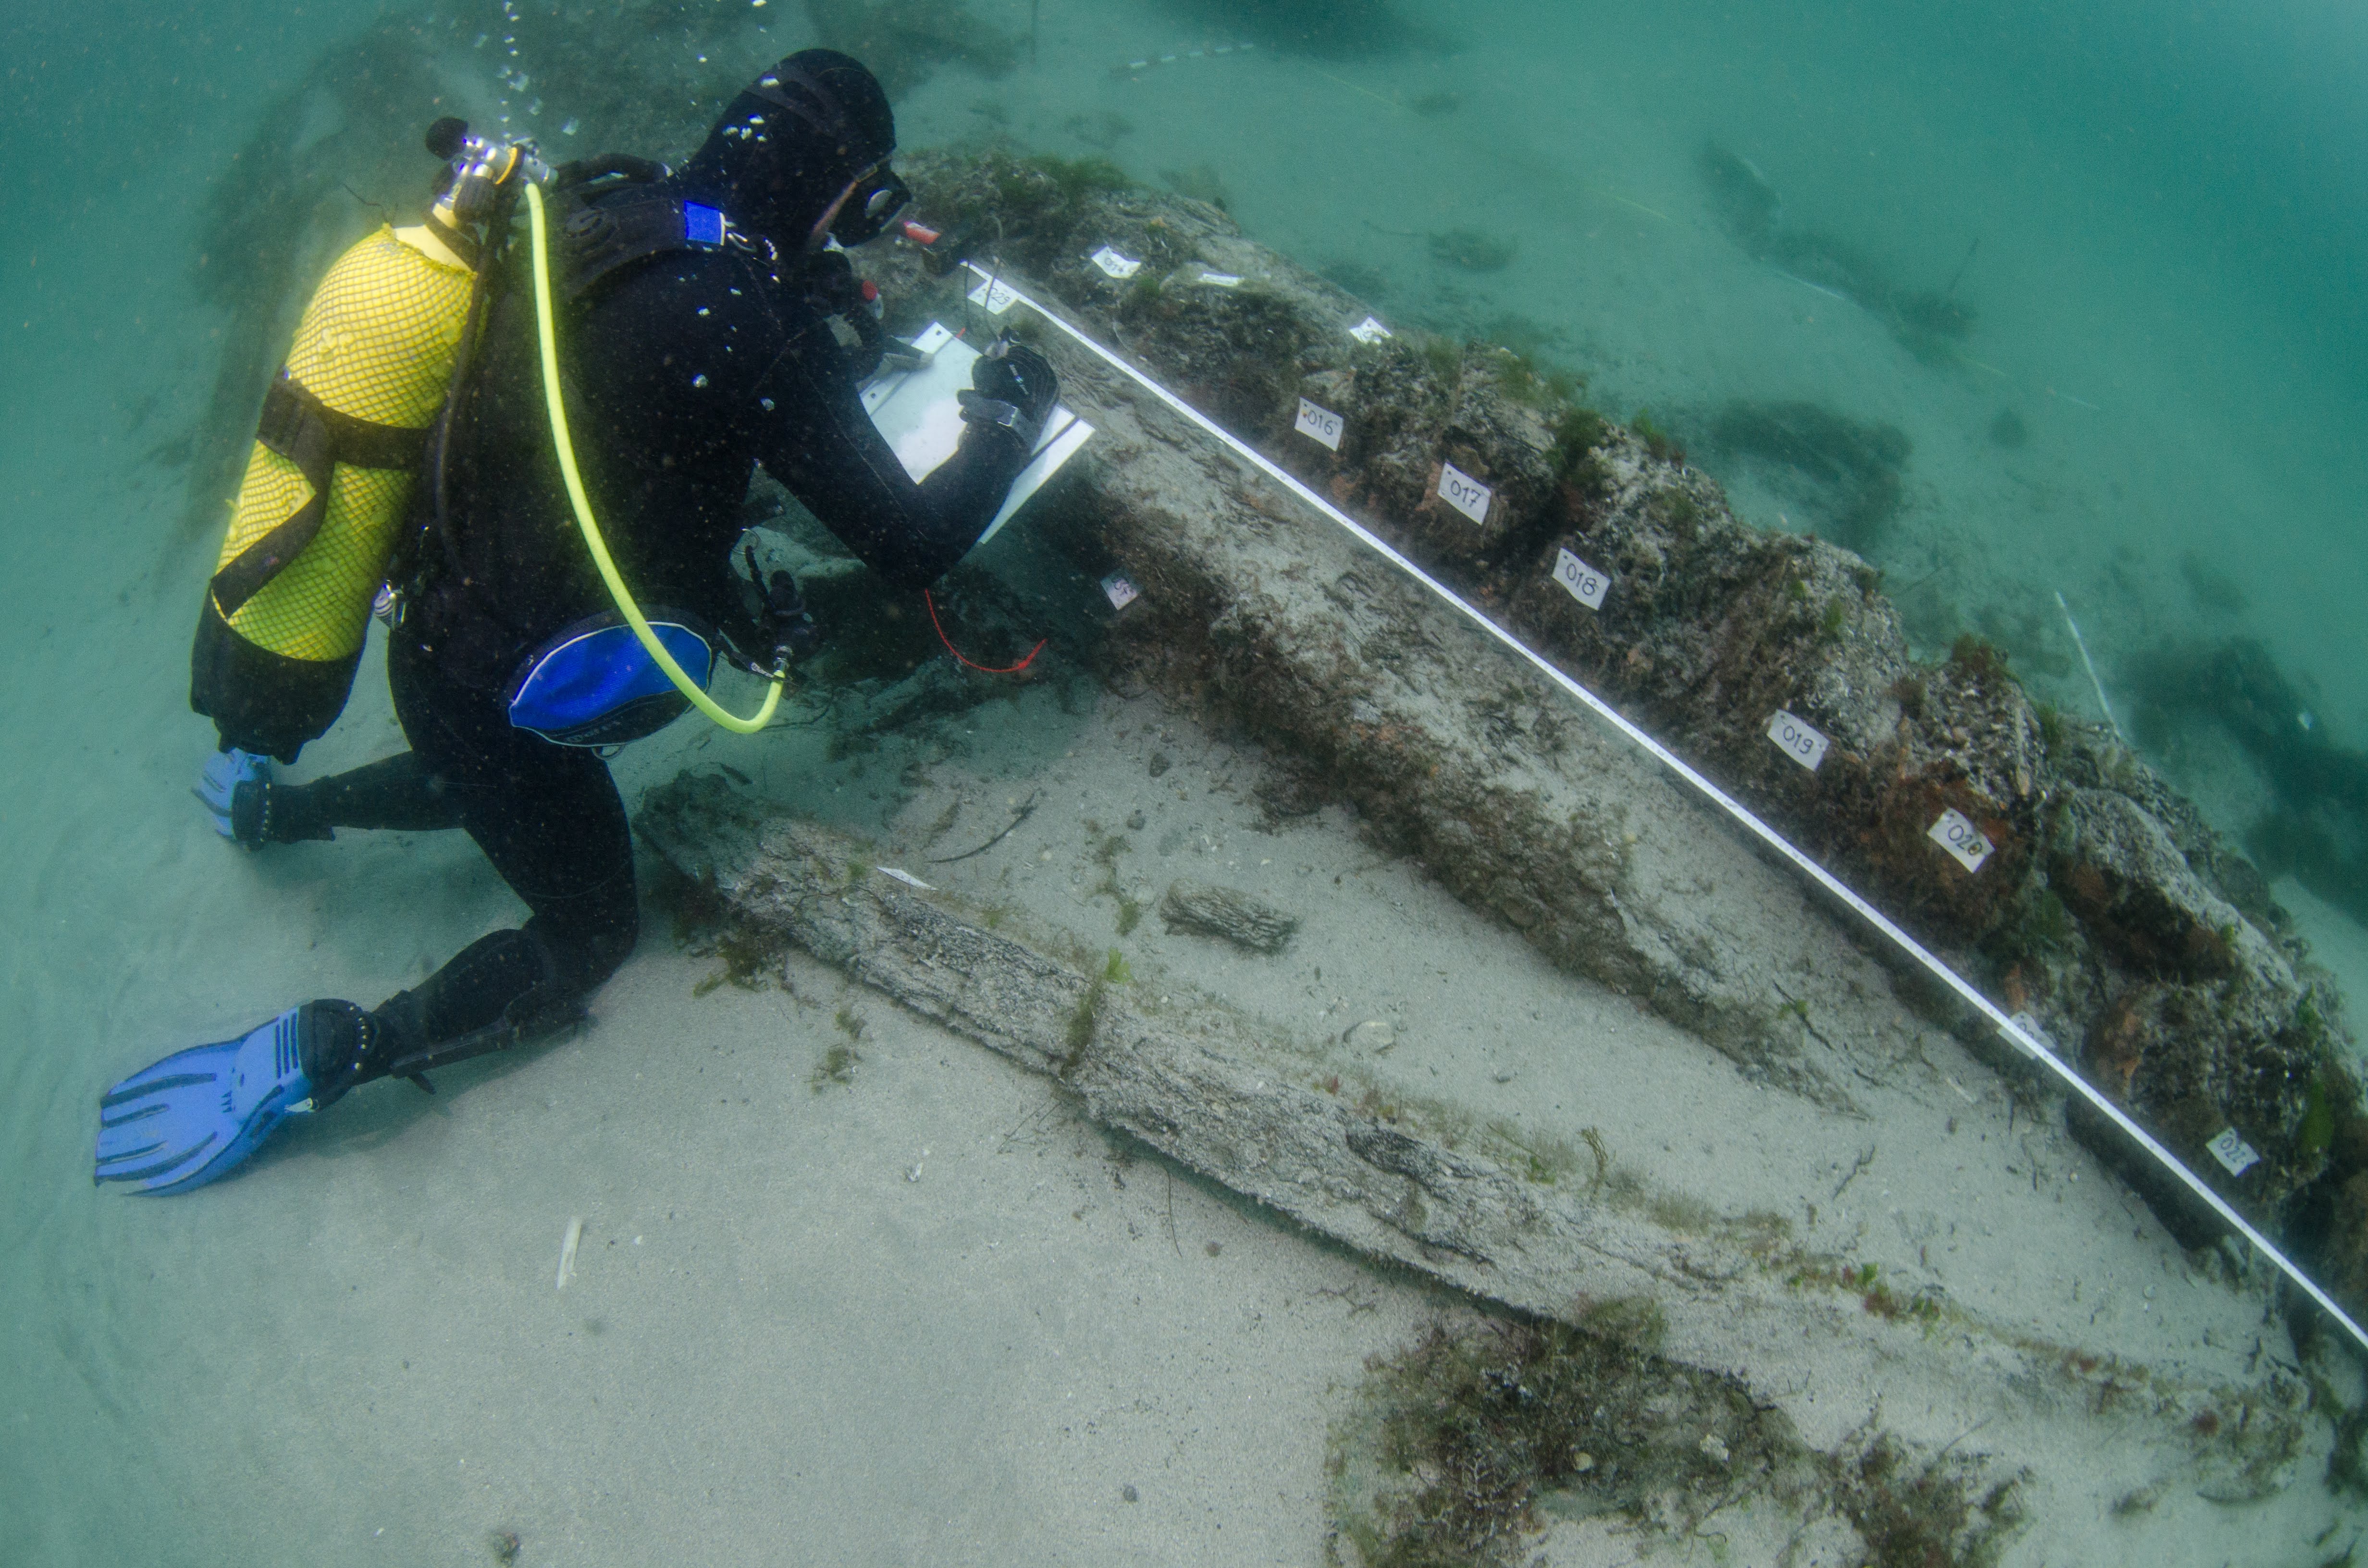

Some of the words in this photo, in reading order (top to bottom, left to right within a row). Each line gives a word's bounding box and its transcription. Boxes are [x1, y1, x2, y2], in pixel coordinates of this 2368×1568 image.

[1307, 410, 1333, 435] 016
[1450, 479, 1481, 507] 017
[1566, 563, 1597, 596] 018
[1783, 725, 1814, 755] 019
[1948, 824, 1983, 856] 020
